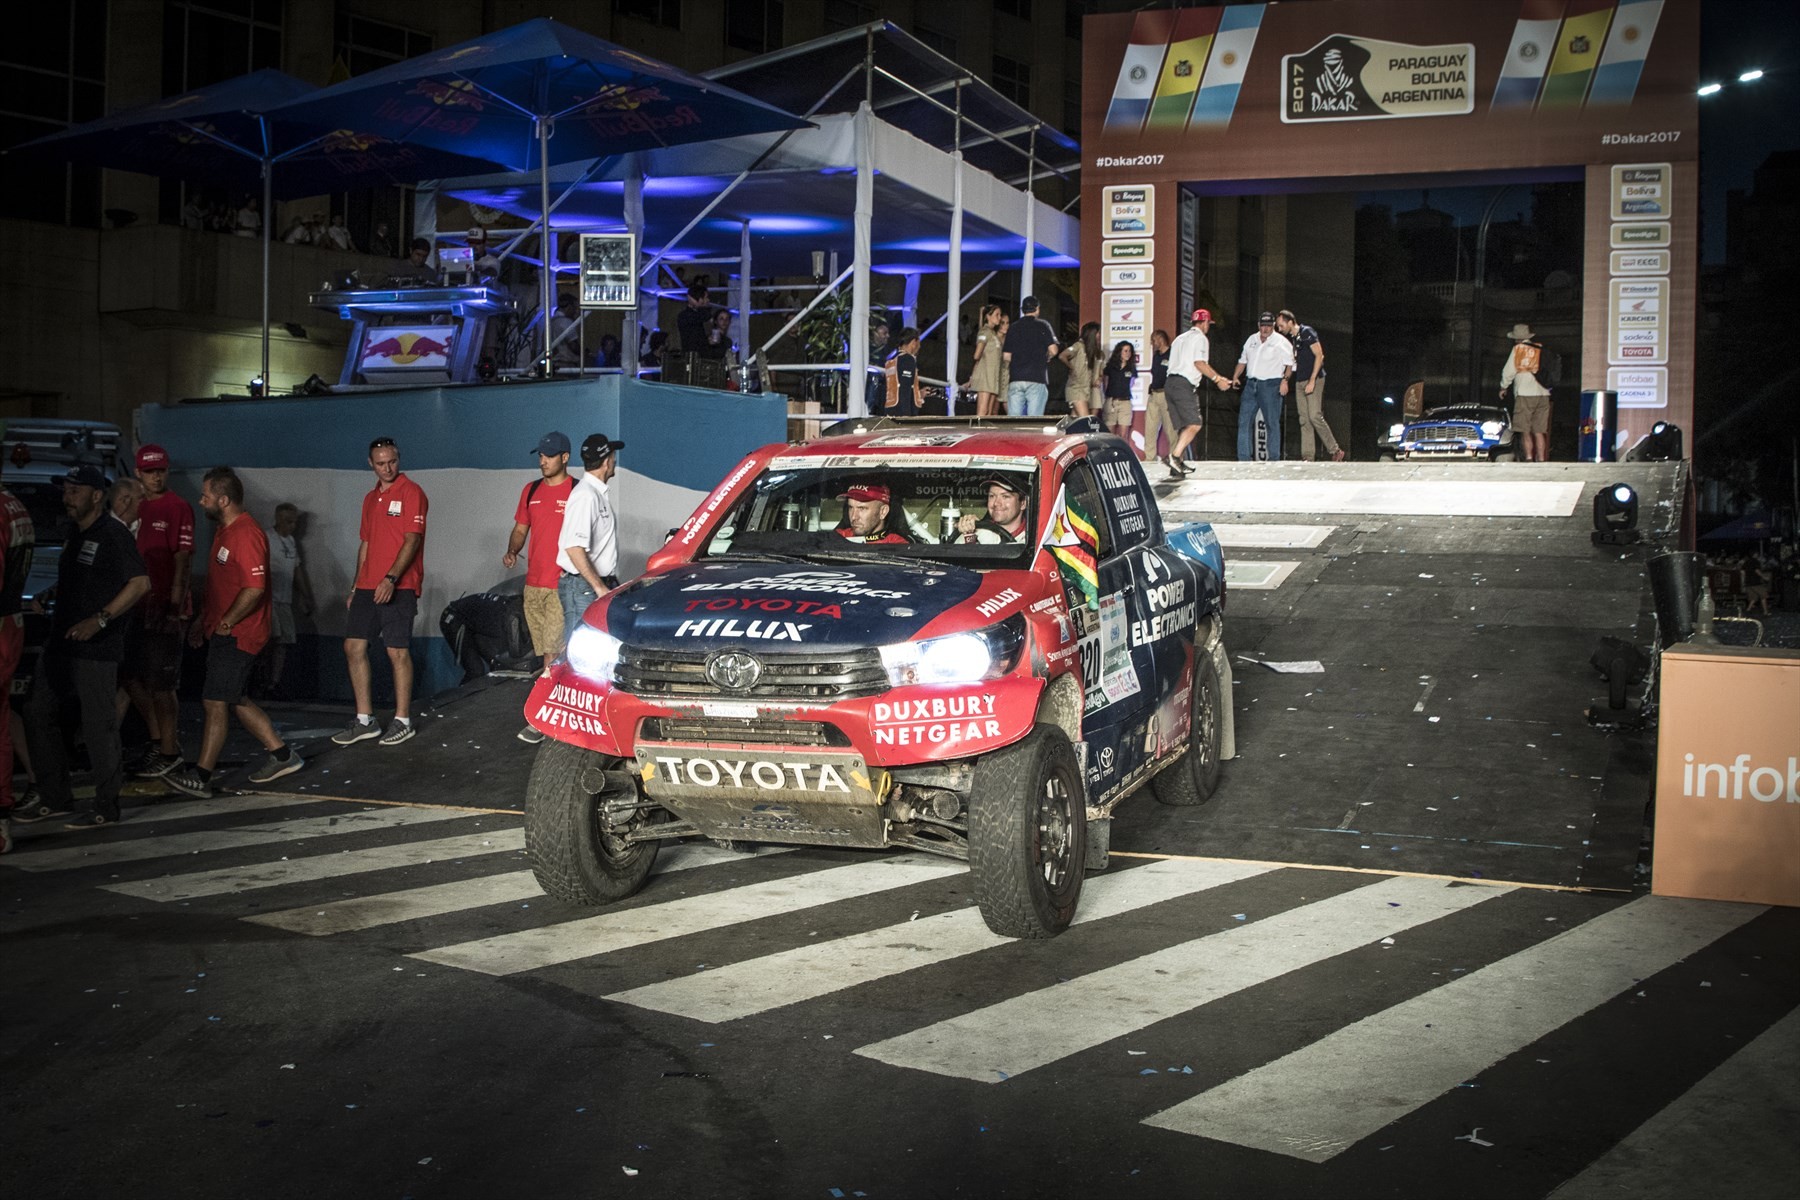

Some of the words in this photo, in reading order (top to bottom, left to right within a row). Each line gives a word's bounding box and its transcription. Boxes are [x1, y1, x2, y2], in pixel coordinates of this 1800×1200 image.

[1388, 54, 1467, 71] PARAGUAY
[1292, 63, 1305, 113] 2017
[1411, 71, 1467, 85] BOLIVIA
[1310, 91, 1358, 112] DAKAR
[1381, 88, 1466, 104] ARGENTINA
[1601, 131, 1681, 145] #Dakar2017
[1096, 154, 1164, 168] #Dakar2017
[1114, 220, 1143, 230] Argentina
[1623, 348, 1652, 356] TOYOTA
[1621, 374, 1654, 384] infobae
[1097, 460, 1137, 490] HILUX
[915, 486, 955, 495] SOUTH
[681, 511, 711, 545] POWER
[707, 459, 757, 512] ELECTRONICS
[1119, 514, 1146, 535] NETGEAR
[680, 583, 912, 599] ELECTRONICS
[740, 576, 868, 587] POWER
[975, 587, 1023, 618] HILUX
[1146, 579, 1185, 612] POWER
[684, 598, 843, 619] TOYOTA
[674, 619, 813, 642] HILUX
[1131, 602, 1195, 648] ELECTRONICS
[548, 684, 604, 713] DUXBURY
[874, 693, 997, 722] DUXBURY
[535, 704, 607, 736] NETGEAR
[875, 718, 1002, 747] NETGEAR
[655, 756, 852, 793] TOYOTA
